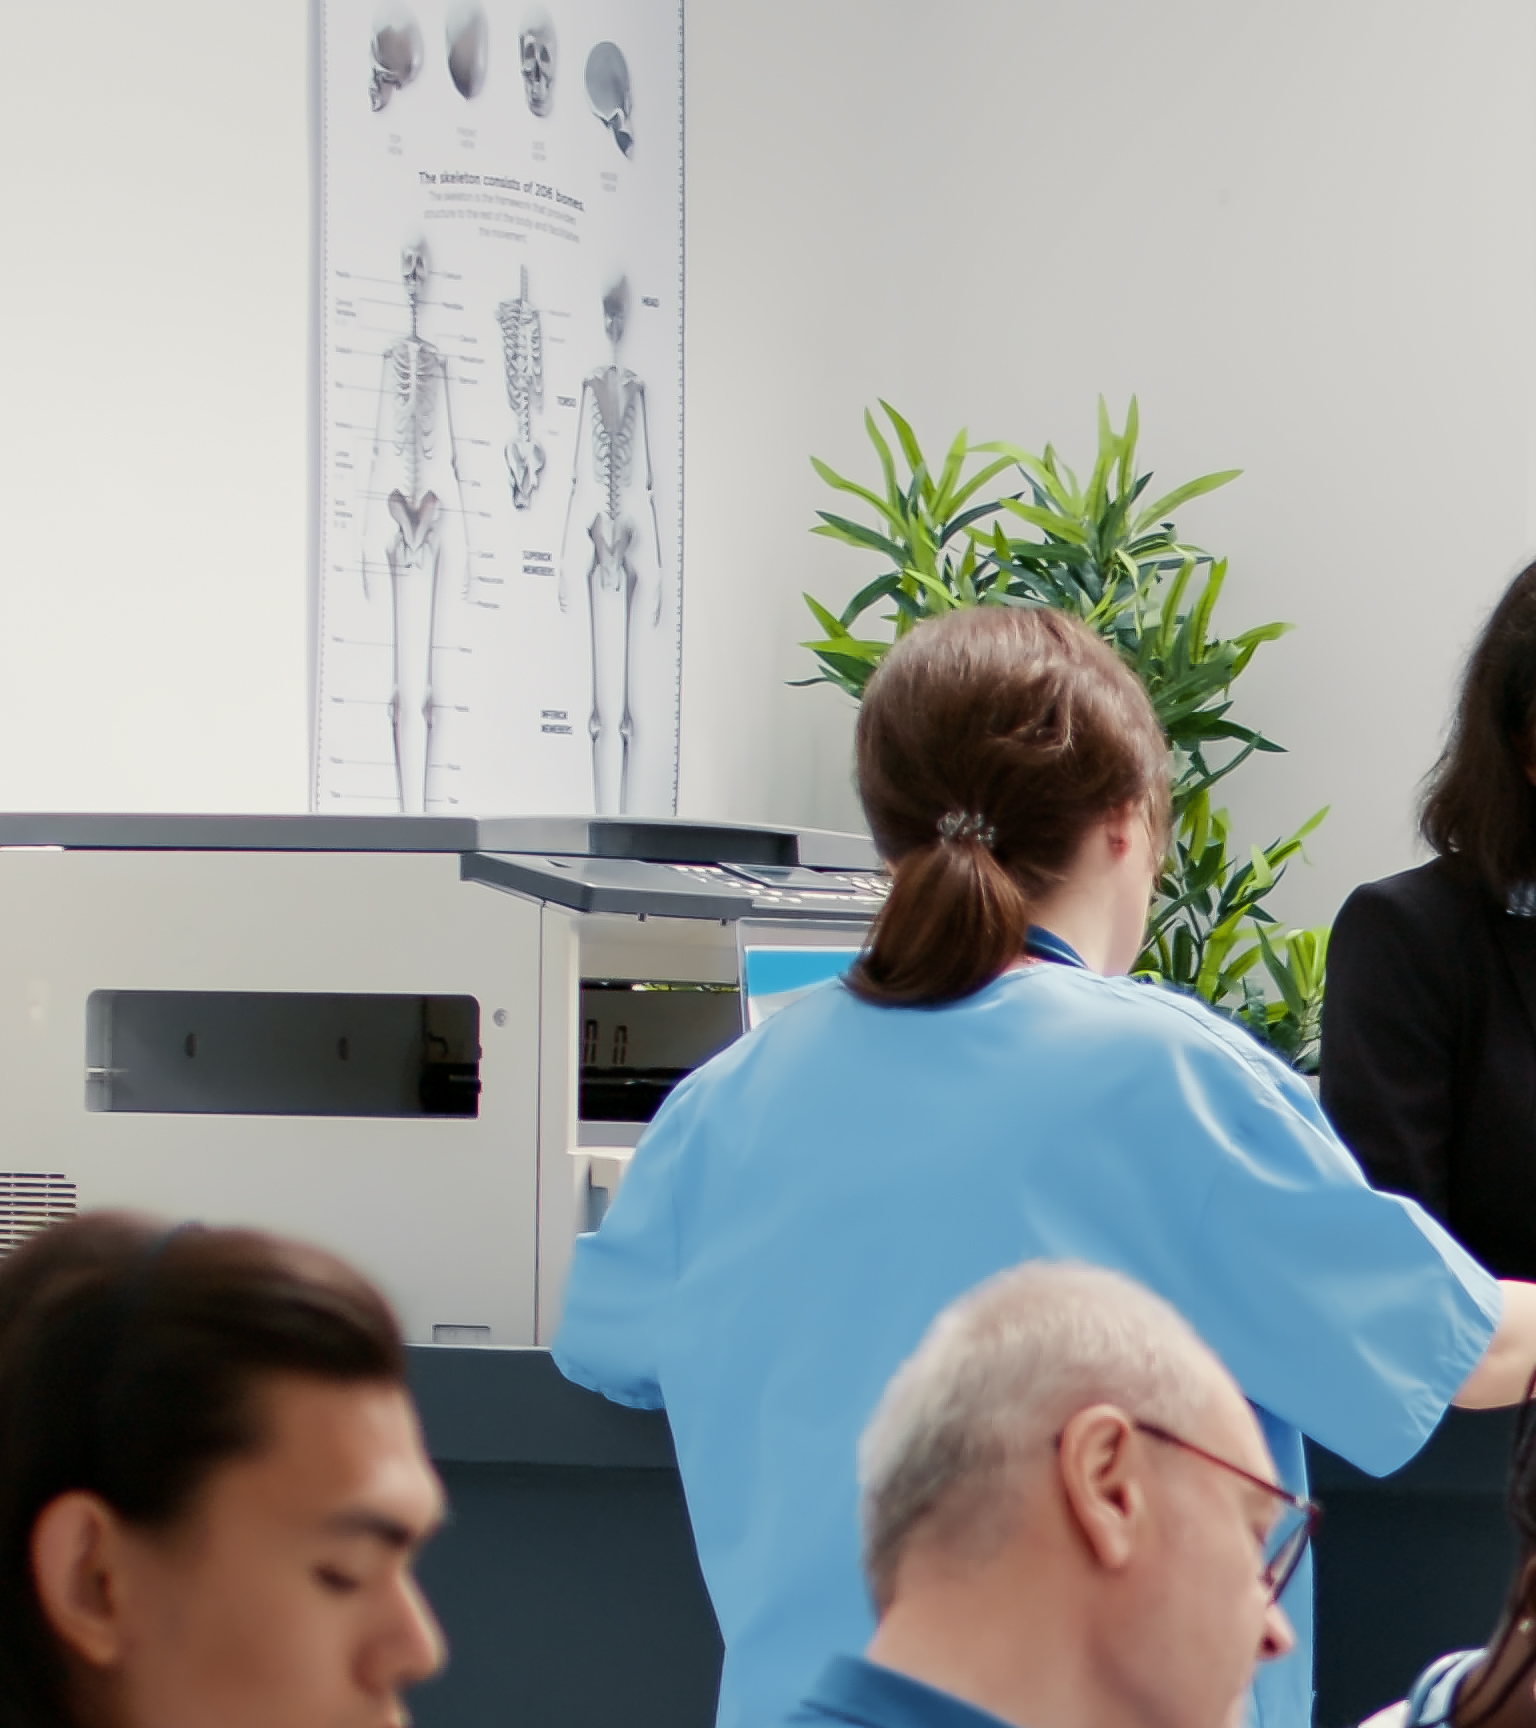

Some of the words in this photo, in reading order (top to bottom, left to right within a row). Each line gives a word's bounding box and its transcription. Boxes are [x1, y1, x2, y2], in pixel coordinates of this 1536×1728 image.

[419, 171, 436, 184] The
[440, 170, 480, 184] skeleton
[523, 182, 533, 192] of
